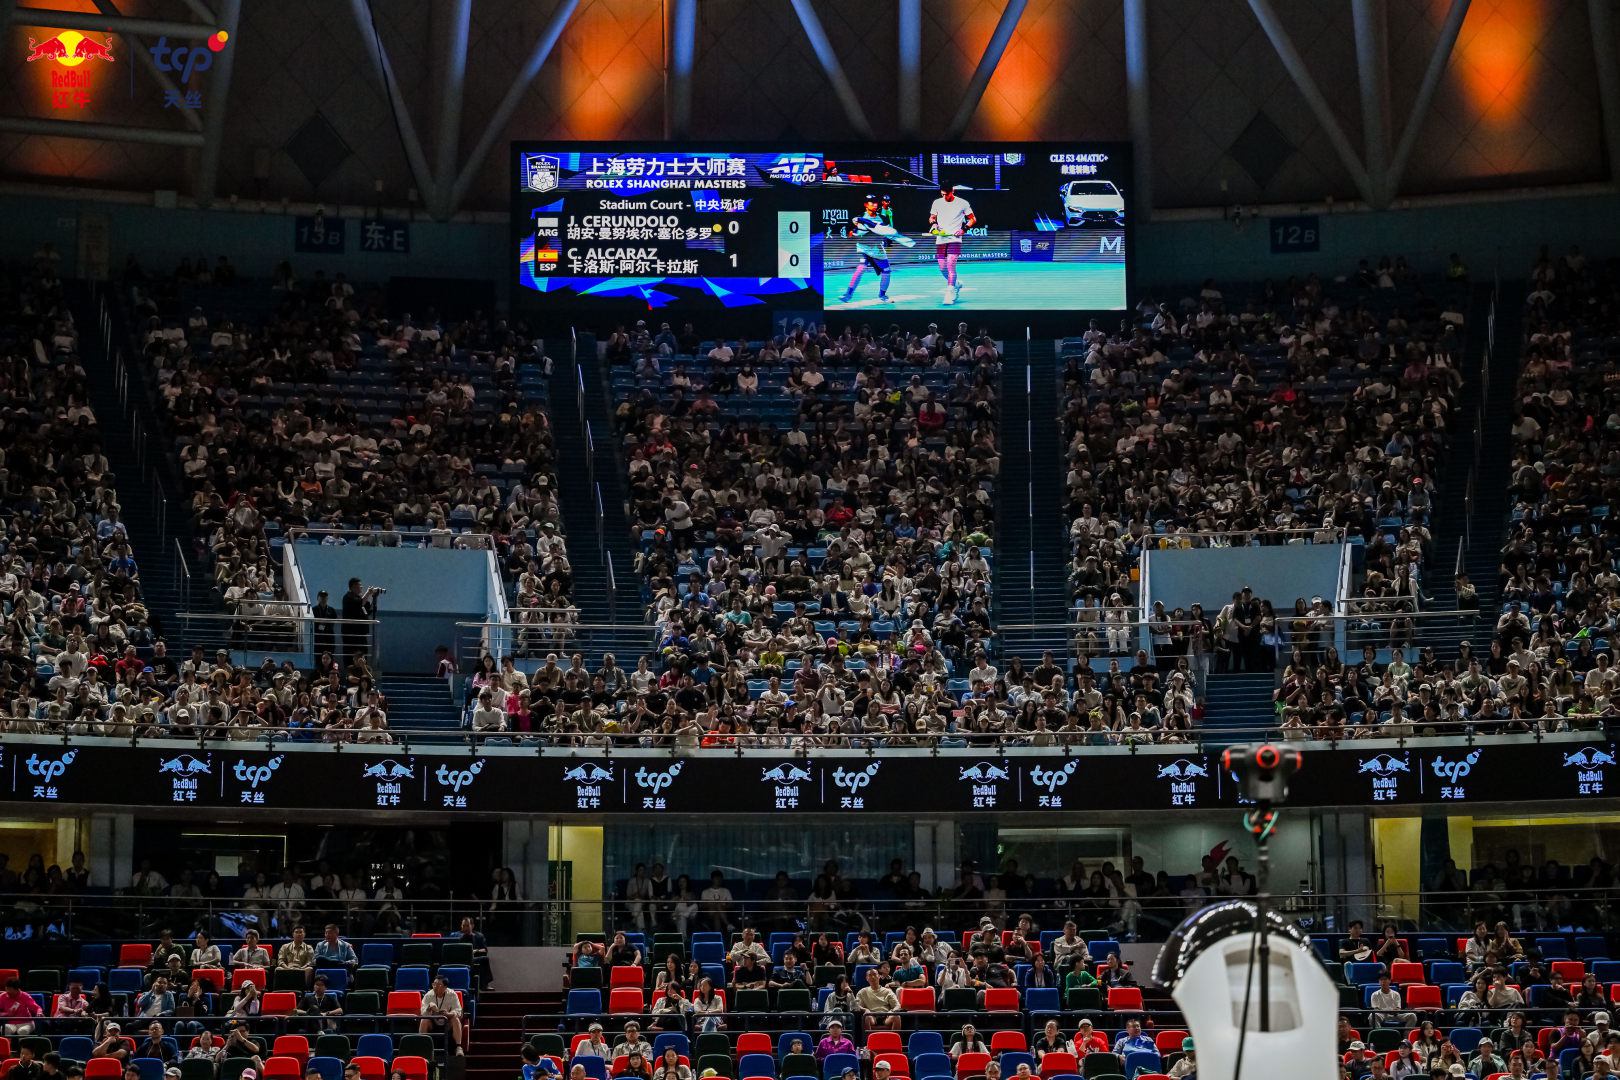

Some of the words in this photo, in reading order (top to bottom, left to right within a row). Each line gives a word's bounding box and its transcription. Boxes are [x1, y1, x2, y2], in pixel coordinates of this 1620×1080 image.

[767, 158, 819, 173] ATP
[943, 155, 988, 165] Heineken
[586, 157, 746, 176] 上海劳力士大师赛
[792, 174, 816, 182] 1000
[586, 180, 624, 189] ROLEX
[627, 180, 691, 189] SHANGHAI
[694, 180, 746, 189] MASTERS
[600, 200, 647, 210] Stadium
[650, 200, 684, 210] Court
[695, 199, 745, 211] 中央场馆
[567, 215, 579, 227] J.
[583, 215, 679, 228] CERUNDOLO
[728, 221, 739, 234] 0
[538, 229, 558, 237] ARG
[567, 227, 712, 240] 胡安·曼努埃尔·塞伦多罗
[789, 222, 799, 234] 0
[1275, 226, 1316, 245] 12B
[567, 248, 582, 260] C.
[586, 248, 657, 260] ALCARAZ
[730, 254, 738, 267] 1
[789, 255, 799, 267] 0
[540, 263, 557, 271] ESP
[568, 260, 698, 274] 卡洛斯·阿尔卡拉斯
[26, 753, 65, 783] tcp
[233, 759, 272, 788] tcp
[1431, 753, 1470, 783] tcp
[436, 762, 475, 792] tcp
[635, 764, 674, 794] tcp
[832, 764, 871, 794] tcp
[1030, 762, 1069, 792] tcp
[34, 786, 57, 798] 天丝
[1441, 786, 1465, 798] 天丝
[1579, 782, 1603, 793] 红牛
[173, 790, 197, 802] 红牛
[241, 791, 264, 803] 天丝
[377, 795, 400, 806] 红牛
[1172, 794, 1195, 805] 红牛
[1373, 789, 1397, 800] 红牛
[444, 796, 467, 807] 天丝
[577, 797, 600, 808] 红牛
[643, 798, 666, 809] 天丝
[775, 798, 799, 808] 红牛
[841, 797, 864, 808] 天丝
[973, 796, 996, 807] 红牛
[1039, 796, 1062, 807] 天丝
